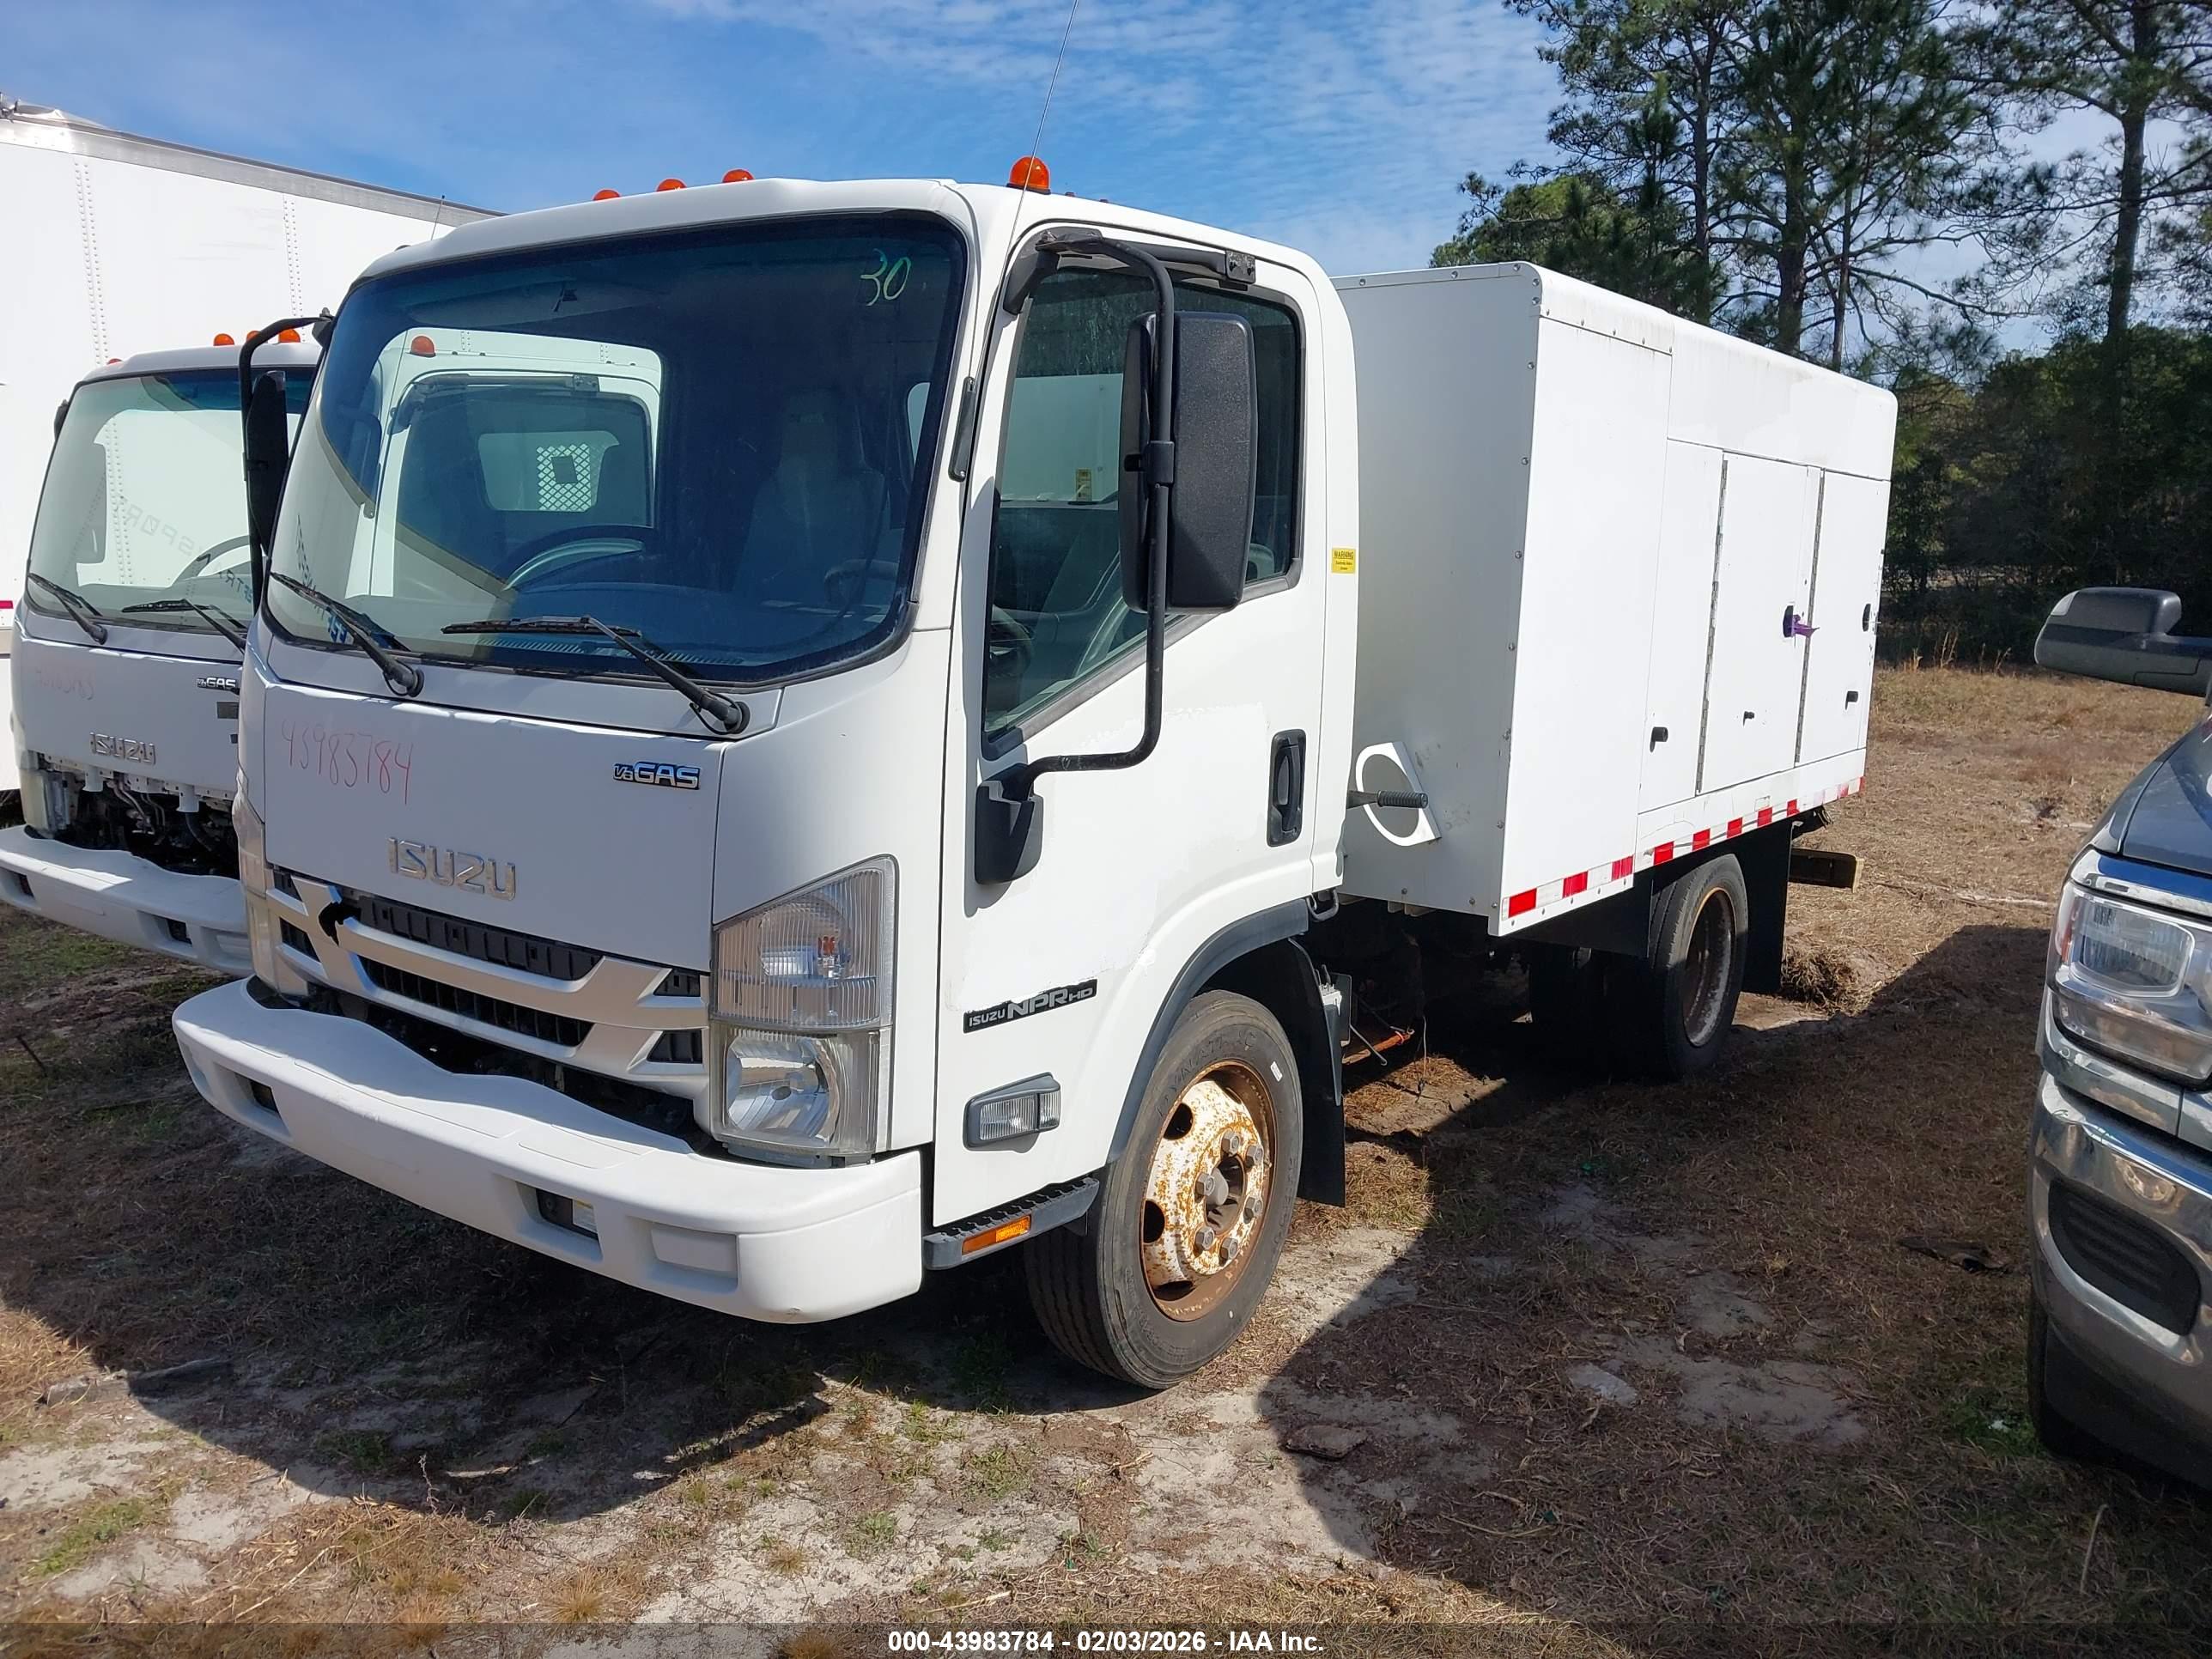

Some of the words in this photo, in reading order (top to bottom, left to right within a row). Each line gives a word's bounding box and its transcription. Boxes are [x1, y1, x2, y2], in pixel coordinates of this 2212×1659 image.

[860, 248, 912, 306] 30
[89, 732, 156, 765] ISUZU
[386, 836, 515, 901] ISUZU
[969, 1008, 1006, 1027] ISUZU
